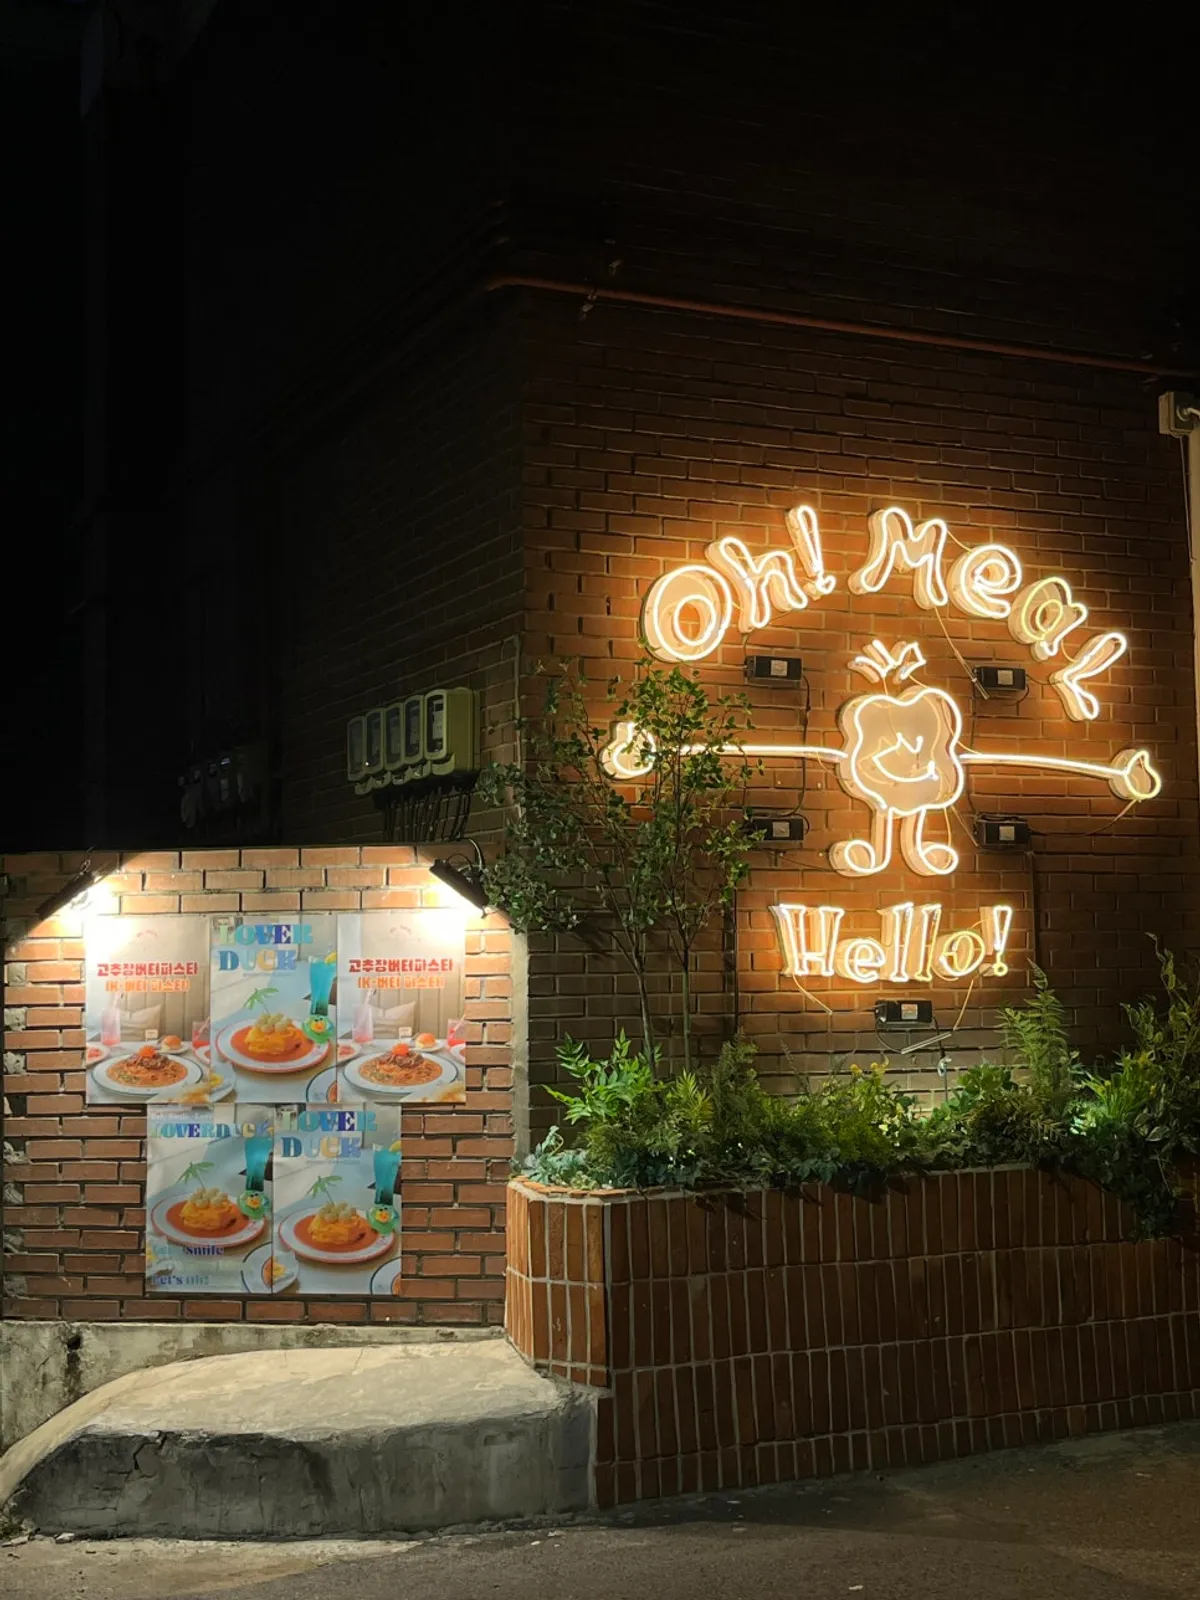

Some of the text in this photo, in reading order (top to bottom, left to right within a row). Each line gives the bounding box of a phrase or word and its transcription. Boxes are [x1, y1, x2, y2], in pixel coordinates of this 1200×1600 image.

[643, 504, 836, 662] Oh!
[218, 923, 314, 946] LOVER
[770, 902, 1013, 983] Hello!
[96, 961, 199, 977] 고추장버터파스타
[217, 949, 297, 971] DUCK
[348, 958, 454, 973] 고추장버터파스타
[280, 1110, 378, 1132] LOVER
[280, 1136, 362, 1158] DUCK
